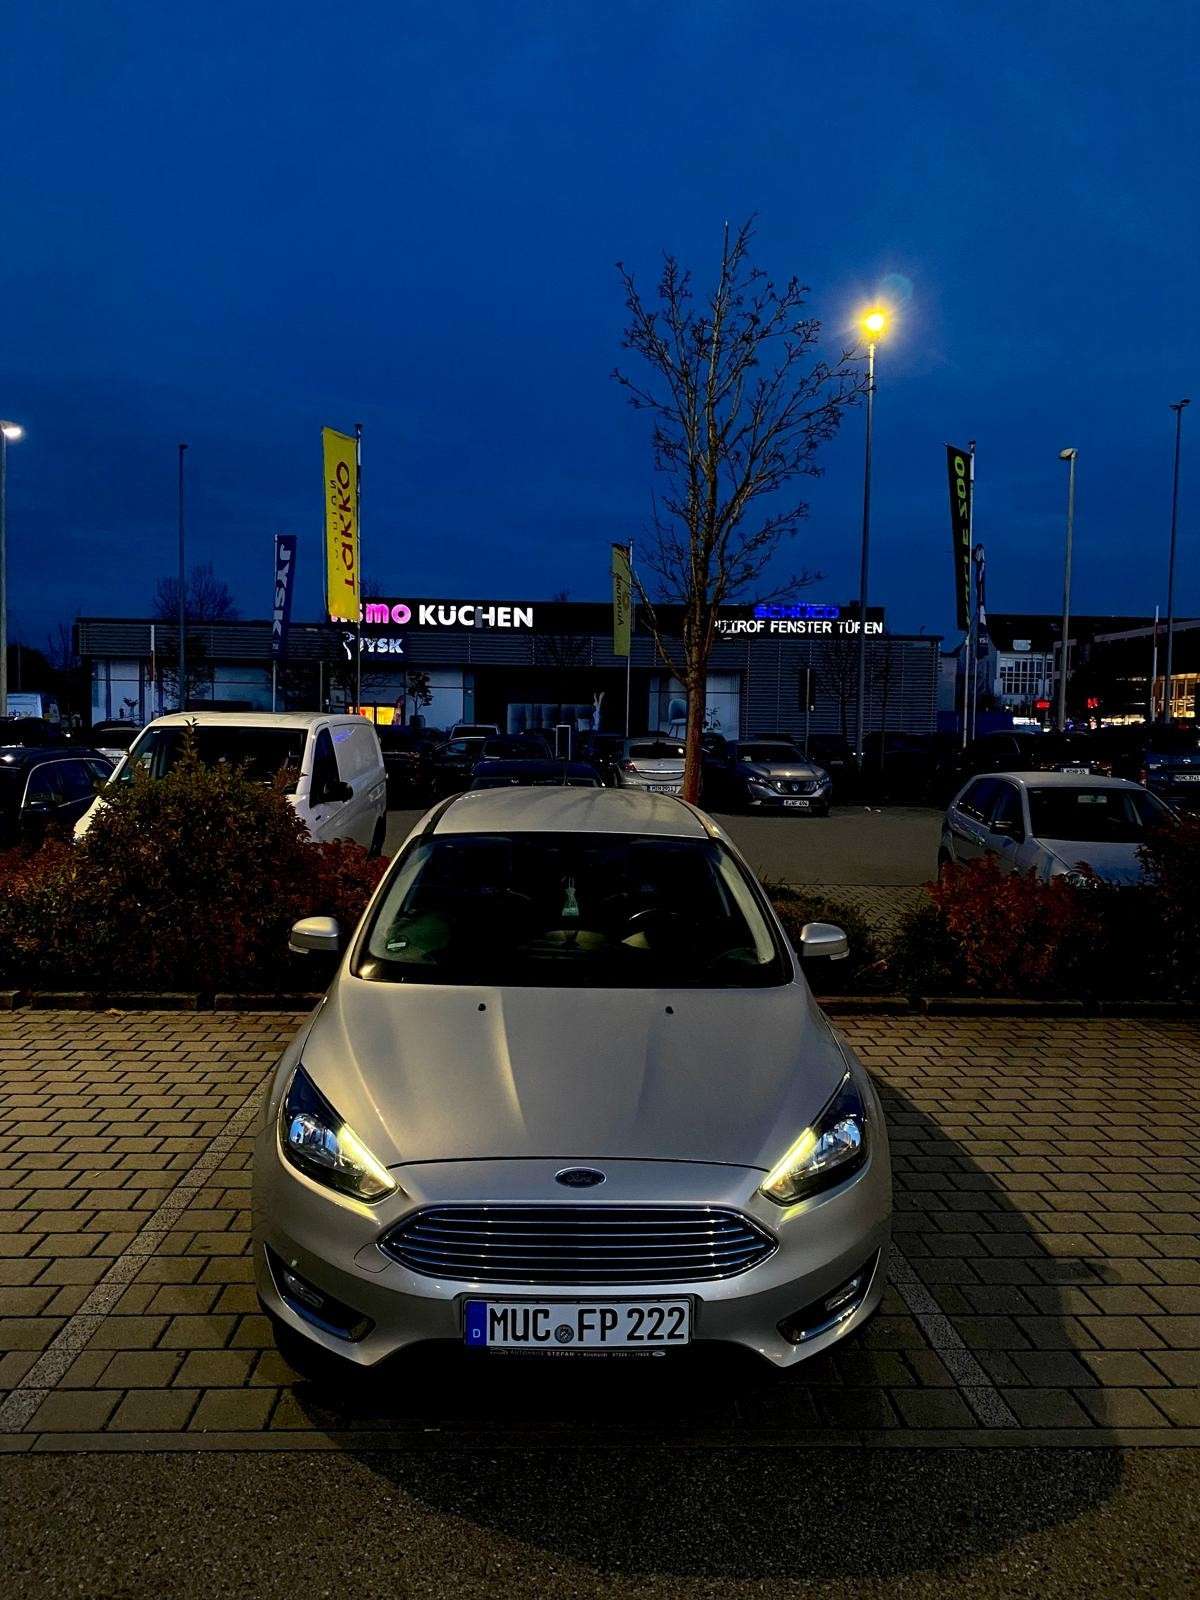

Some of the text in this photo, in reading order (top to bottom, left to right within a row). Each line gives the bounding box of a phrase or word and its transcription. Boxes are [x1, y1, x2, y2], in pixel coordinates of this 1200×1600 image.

[273, 544, 291, 636] JYSK
[418, 604, 534, 628] KÜCHEN
[770, 620, 832, 634] FENSTER
[472, 1328, 480, 1338] D
[489, 1307, 685, 1341] MUC FP 222
